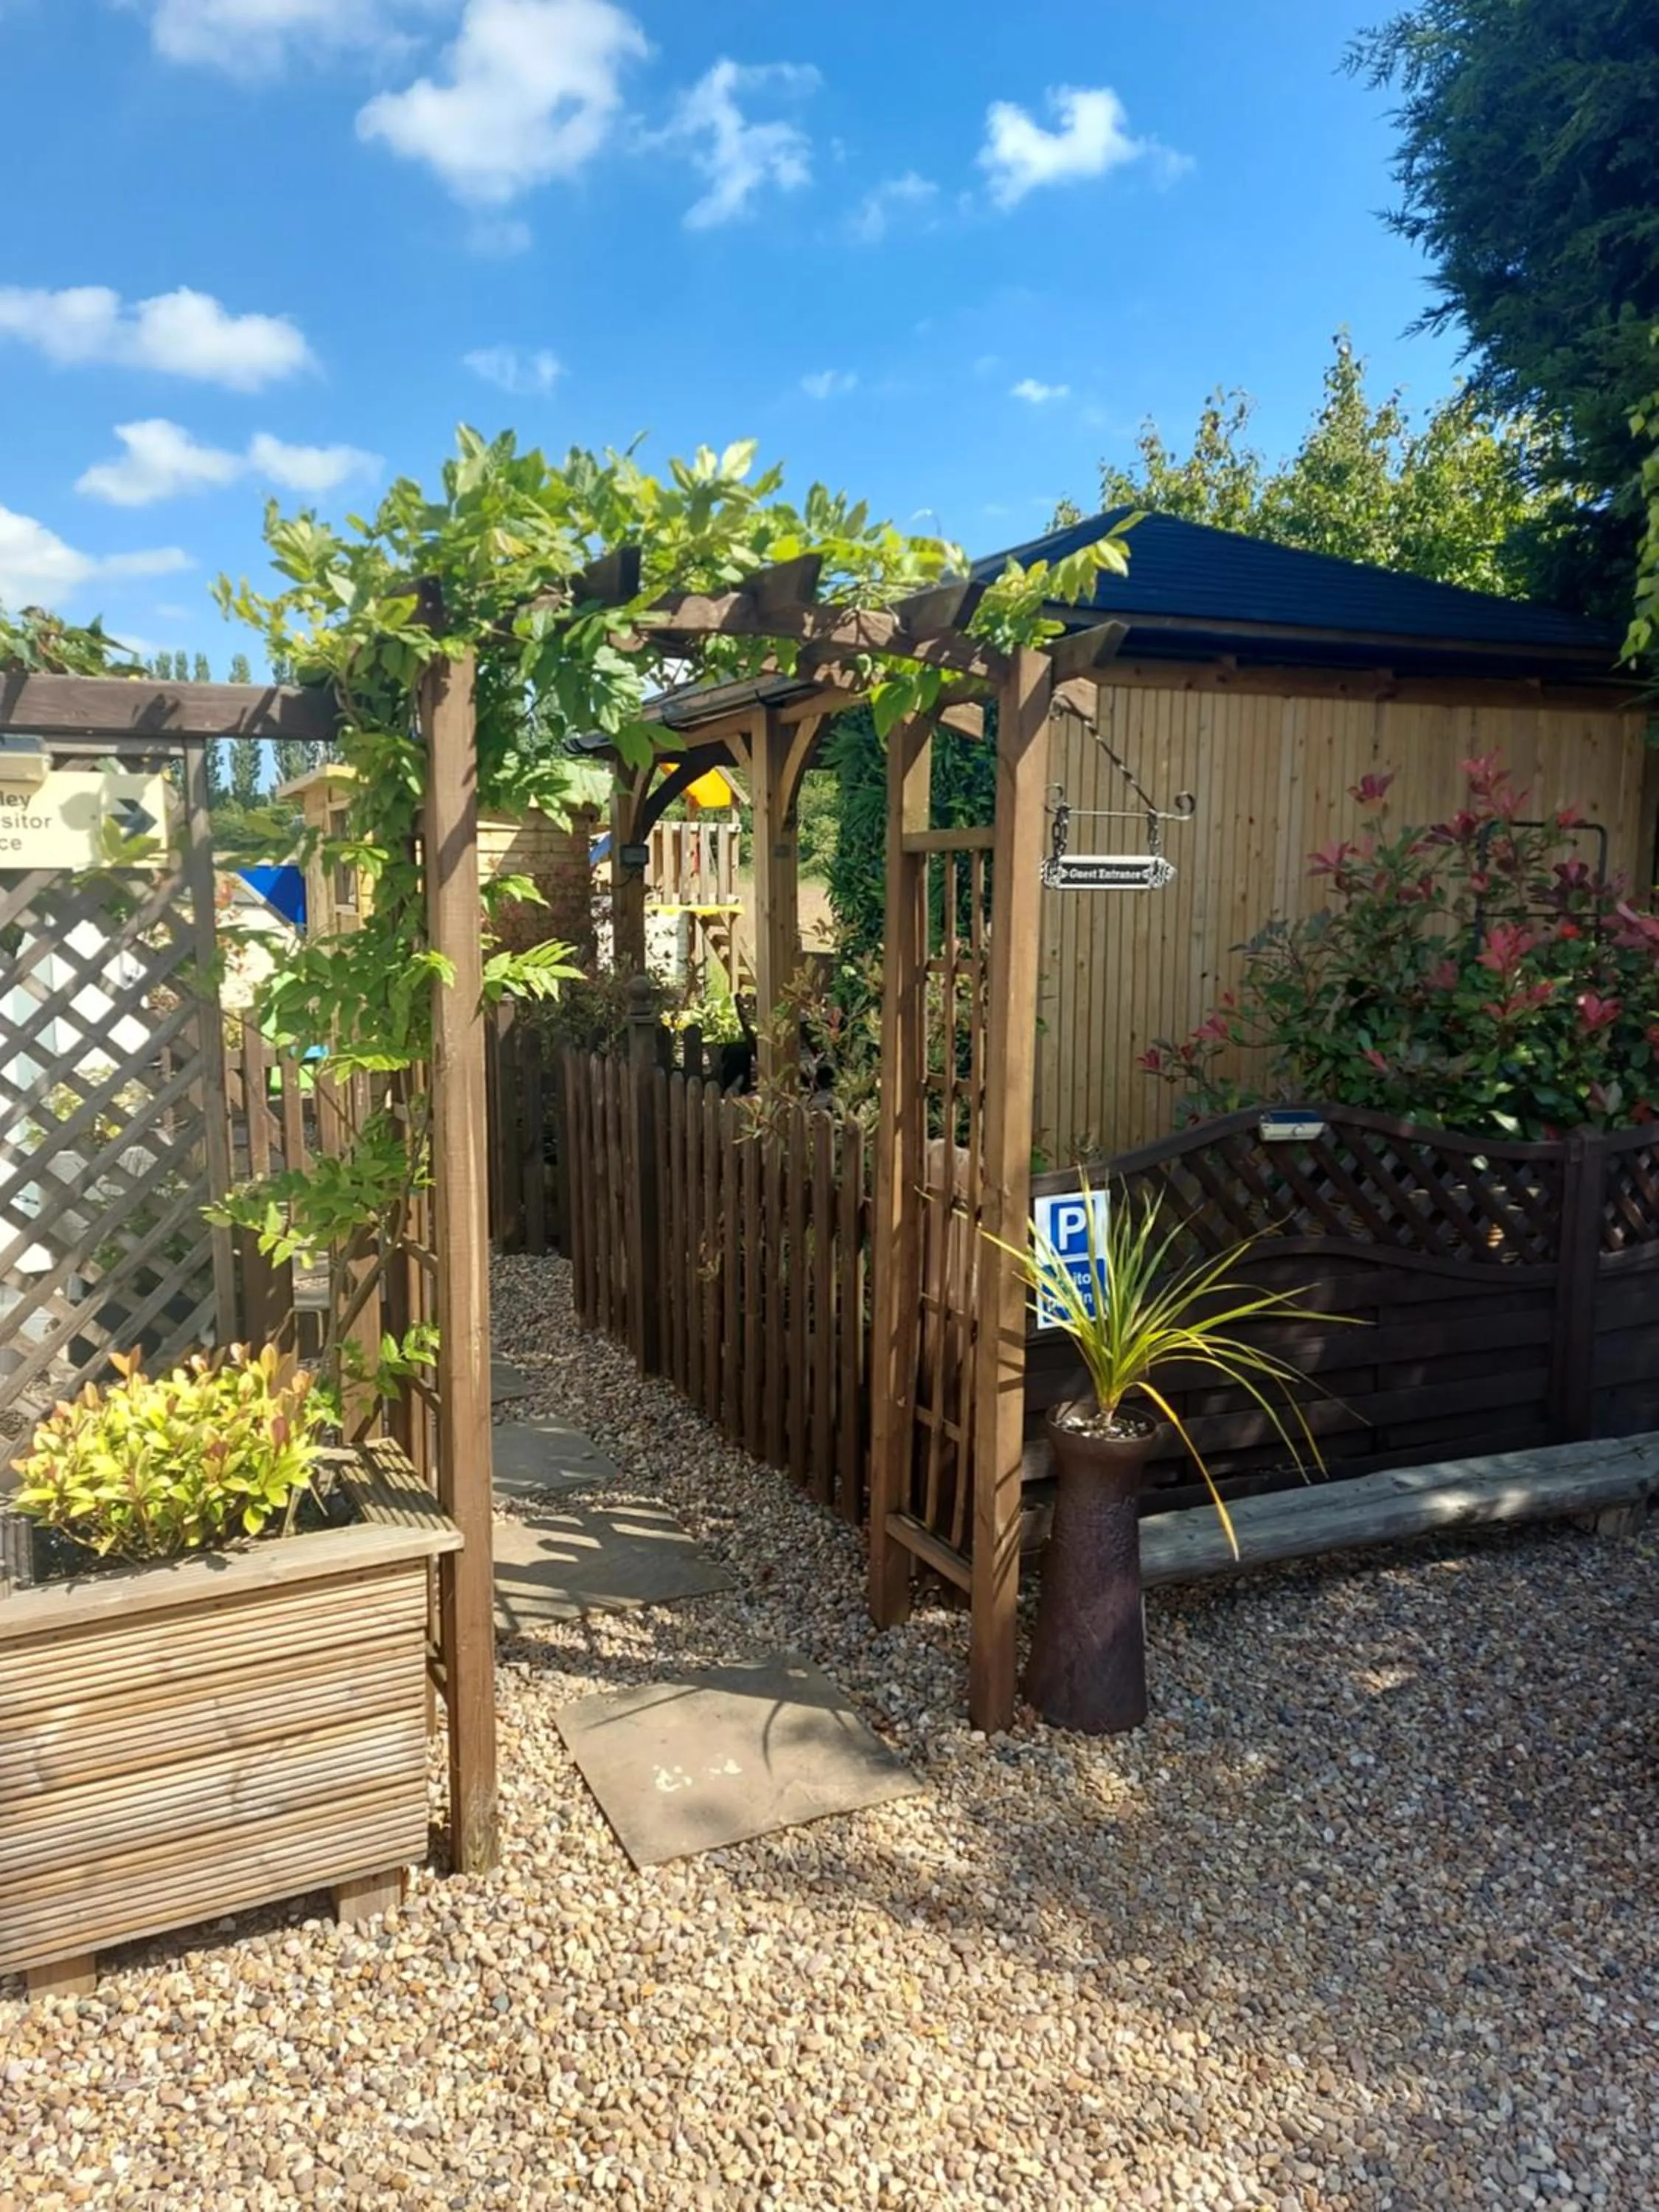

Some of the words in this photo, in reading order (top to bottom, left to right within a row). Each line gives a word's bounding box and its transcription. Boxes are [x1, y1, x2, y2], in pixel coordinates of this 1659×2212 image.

[1070, 869, 1096, 879] Guest
[1099, 869, 1141, 879] Entrance
[1058, 1206, 1088, 1251] P
